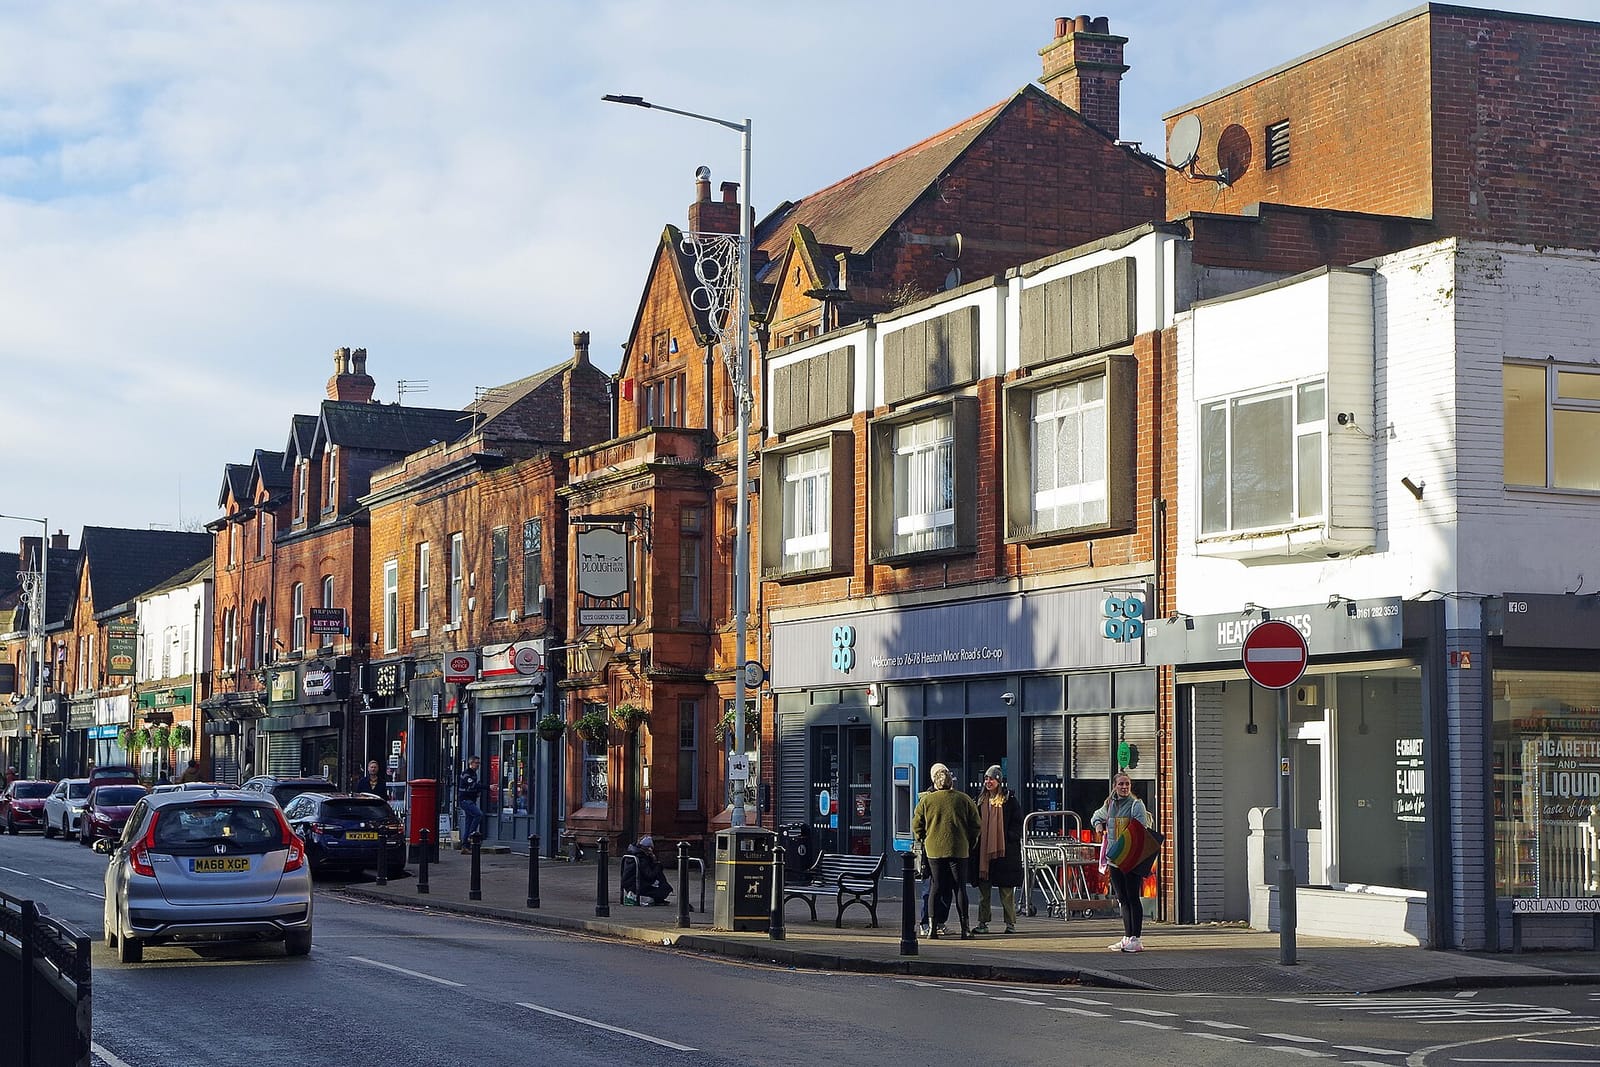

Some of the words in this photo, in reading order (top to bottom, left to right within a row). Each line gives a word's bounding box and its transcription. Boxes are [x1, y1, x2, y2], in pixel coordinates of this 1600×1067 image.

[581, 562, 613, 573] PLOUGH
[1357, 608, 1370, 619] 0161
[1371, 606, 1383, 618] 282
[1383, 605, 1399, 617] 3529
[1217, 618, 1263, 645] HEAT
[871, 655, 898, 668] Welcome
[897, 656, 904, 667] to
[904, 652, 921, 665] 76-78
[921, 651, 943, 664] Heaton
[943, 649, 960, 662] Moor
[960, 647, 981, 660] Road's
[982, 646, 1003, 663] Co-op
[1557, 760, 1577, 769] AND
[1542, 803, 1563, 814] taste
[1566, 799, 1577, 817] of
[196, 859, 225, 870] MA68
[227, 858, 249, 869] XGP
[1513, 899, 1570, 912] PORTLAND
